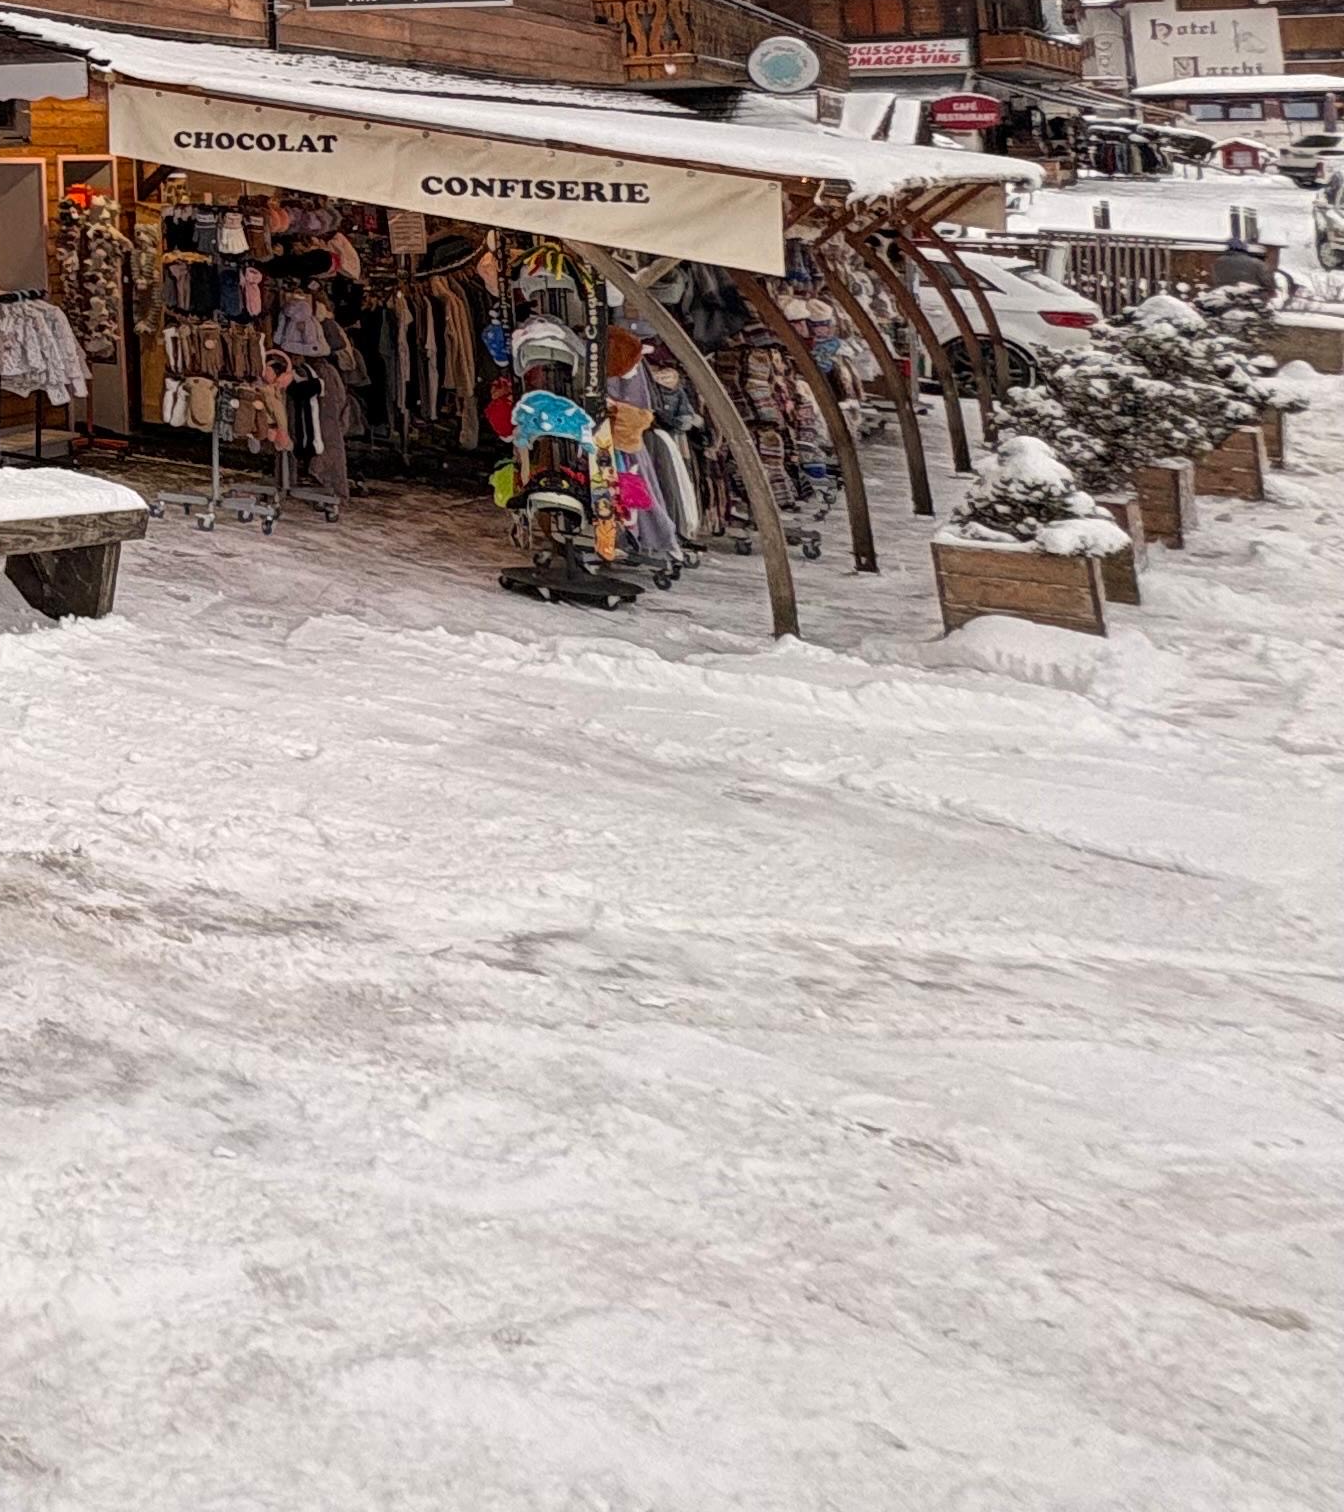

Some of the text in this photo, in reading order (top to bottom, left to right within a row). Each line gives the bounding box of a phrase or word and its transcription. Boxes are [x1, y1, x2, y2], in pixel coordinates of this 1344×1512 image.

[848, 43, 928, 56] UCISSONS
[848, 53, 962, 66] OMAGES-VINS
[952, 100, 978, 112] CAFÉ
[172, 130, 338, 154] CHOCOLAT
[419, 175, 651, 205] CONFISERIE
